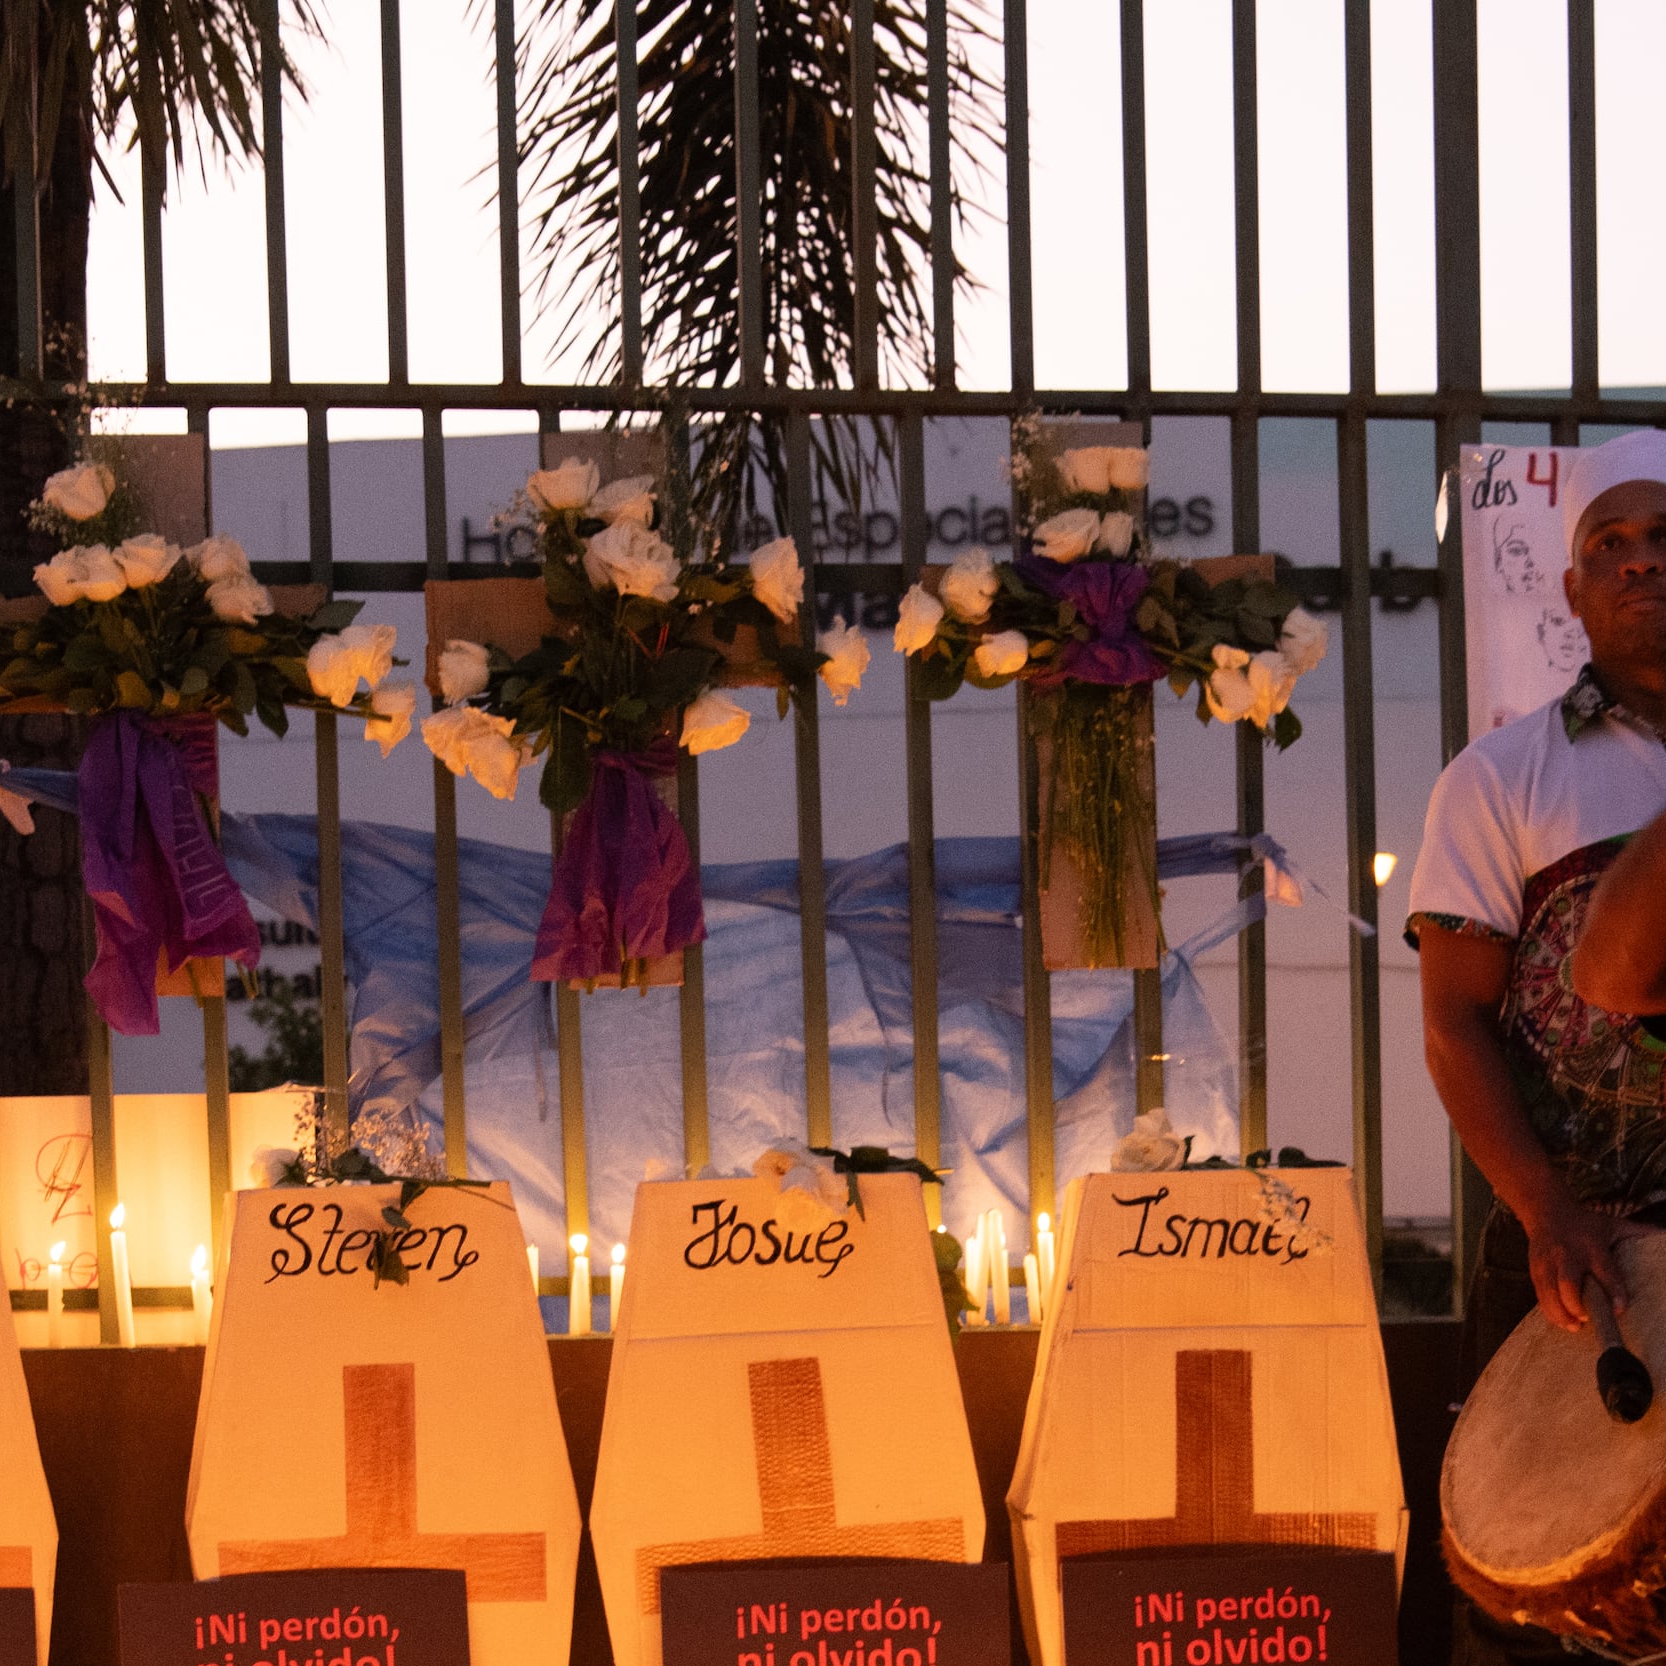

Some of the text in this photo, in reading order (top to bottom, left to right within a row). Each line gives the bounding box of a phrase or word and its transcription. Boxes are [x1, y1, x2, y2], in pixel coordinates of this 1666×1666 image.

[1471, 449, 1518, 511] Los
[1526, 451, 1558, 508] 4
[195, 1606, 401, 1650] ¡Ni perdón,
[736, 1597, 942, 1640] ¡Ni perdón,
[1134, 1586, 1332, 1629] ¡Ni perdón,
[1185, 1625, 1328, 1666] olvido!
